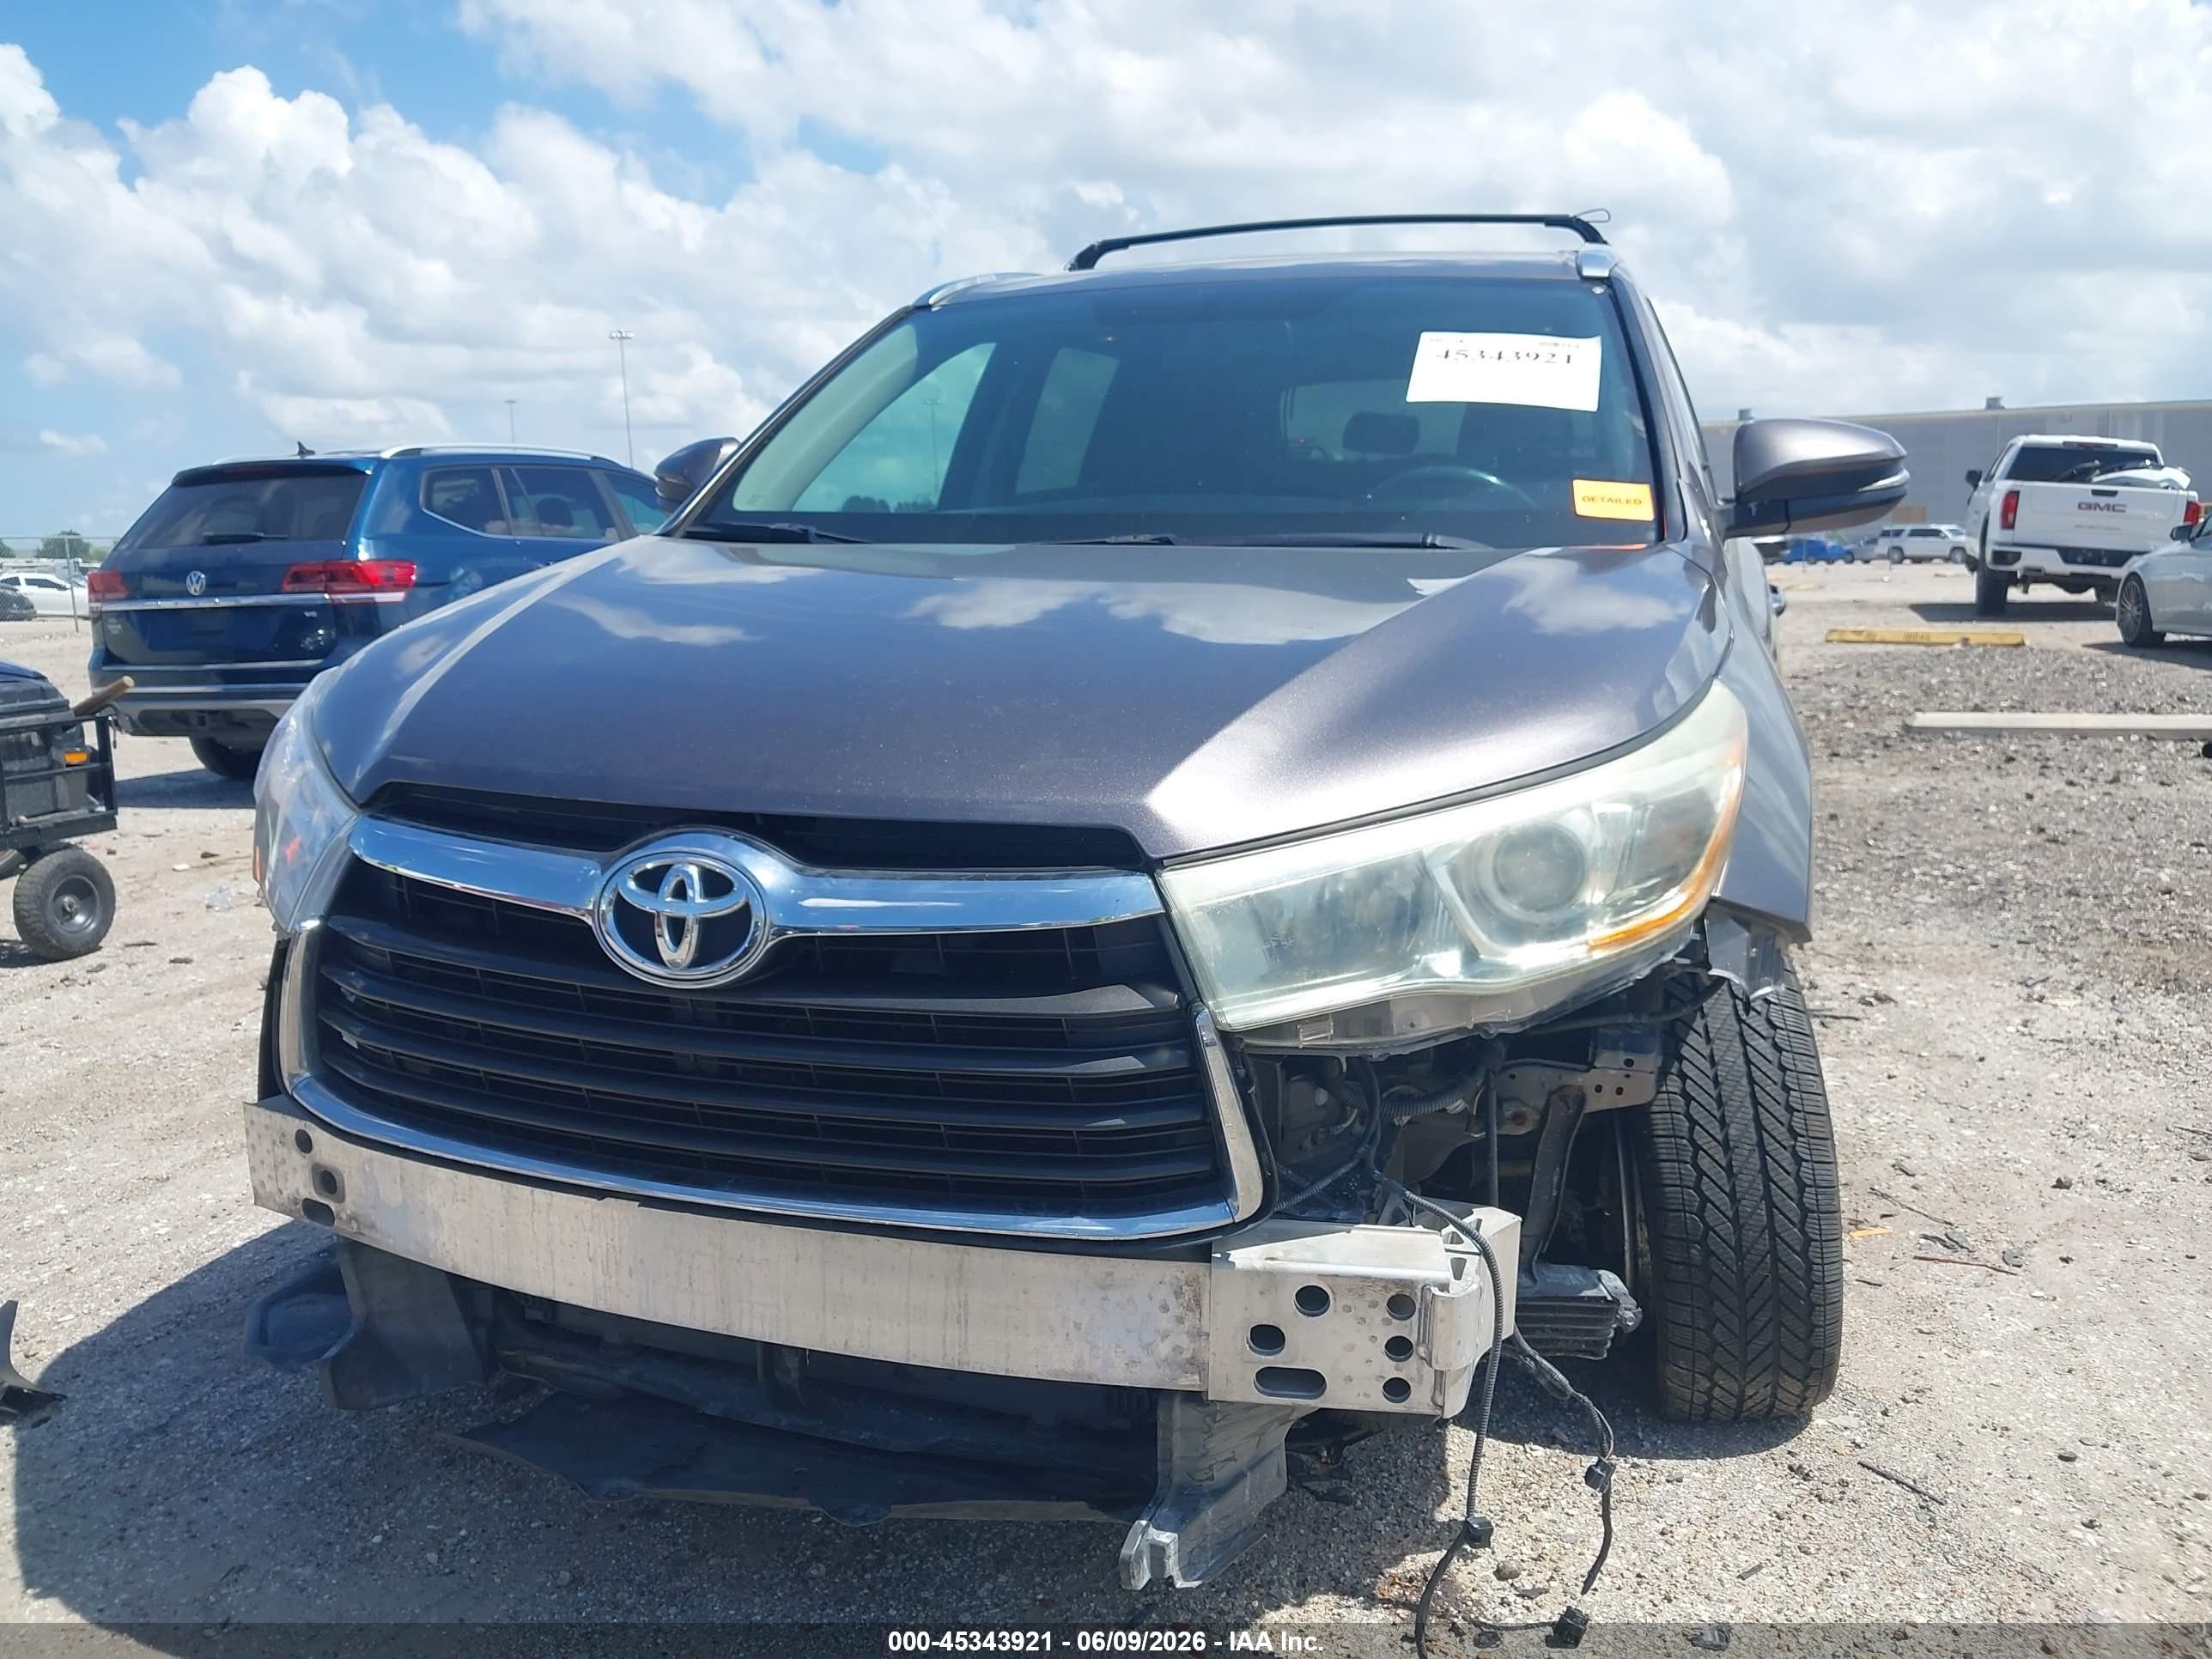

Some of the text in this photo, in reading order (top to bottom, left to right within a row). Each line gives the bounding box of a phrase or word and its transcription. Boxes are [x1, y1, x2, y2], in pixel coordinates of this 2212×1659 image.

[1437, 349, 1572, 364] 45343921
[1582, 495, 1642, 506] DETAILED
[2078, 501, 2127, 513] GMC
